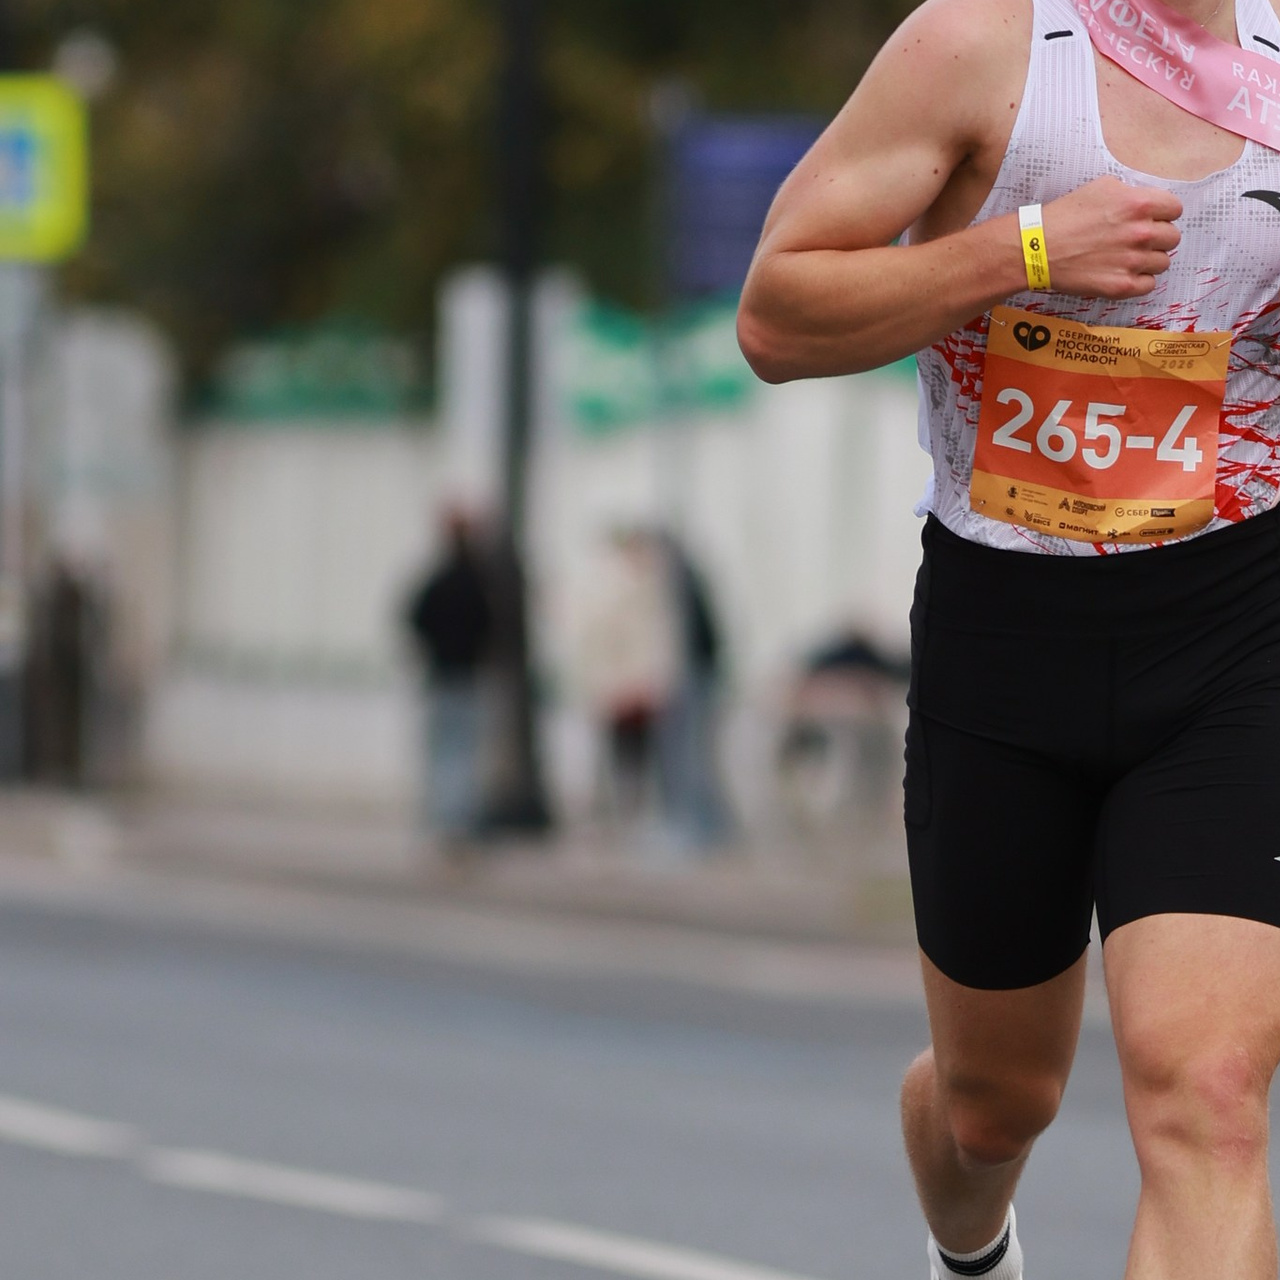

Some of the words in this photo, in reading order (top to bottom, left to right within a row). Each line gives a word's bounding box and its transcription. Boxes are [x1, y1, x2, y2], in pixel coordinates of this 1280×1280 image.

[1058, 329, 1120, 345] СБЕРПРАЙМ
[1056, 338, 1141, 358] МОСКОВСКИЙ
[1054, 349, 1118, 365] МАРАФОН
[1160, 359, 1195, 369] 2026
[992, 387, 1203, 472] 265-4
